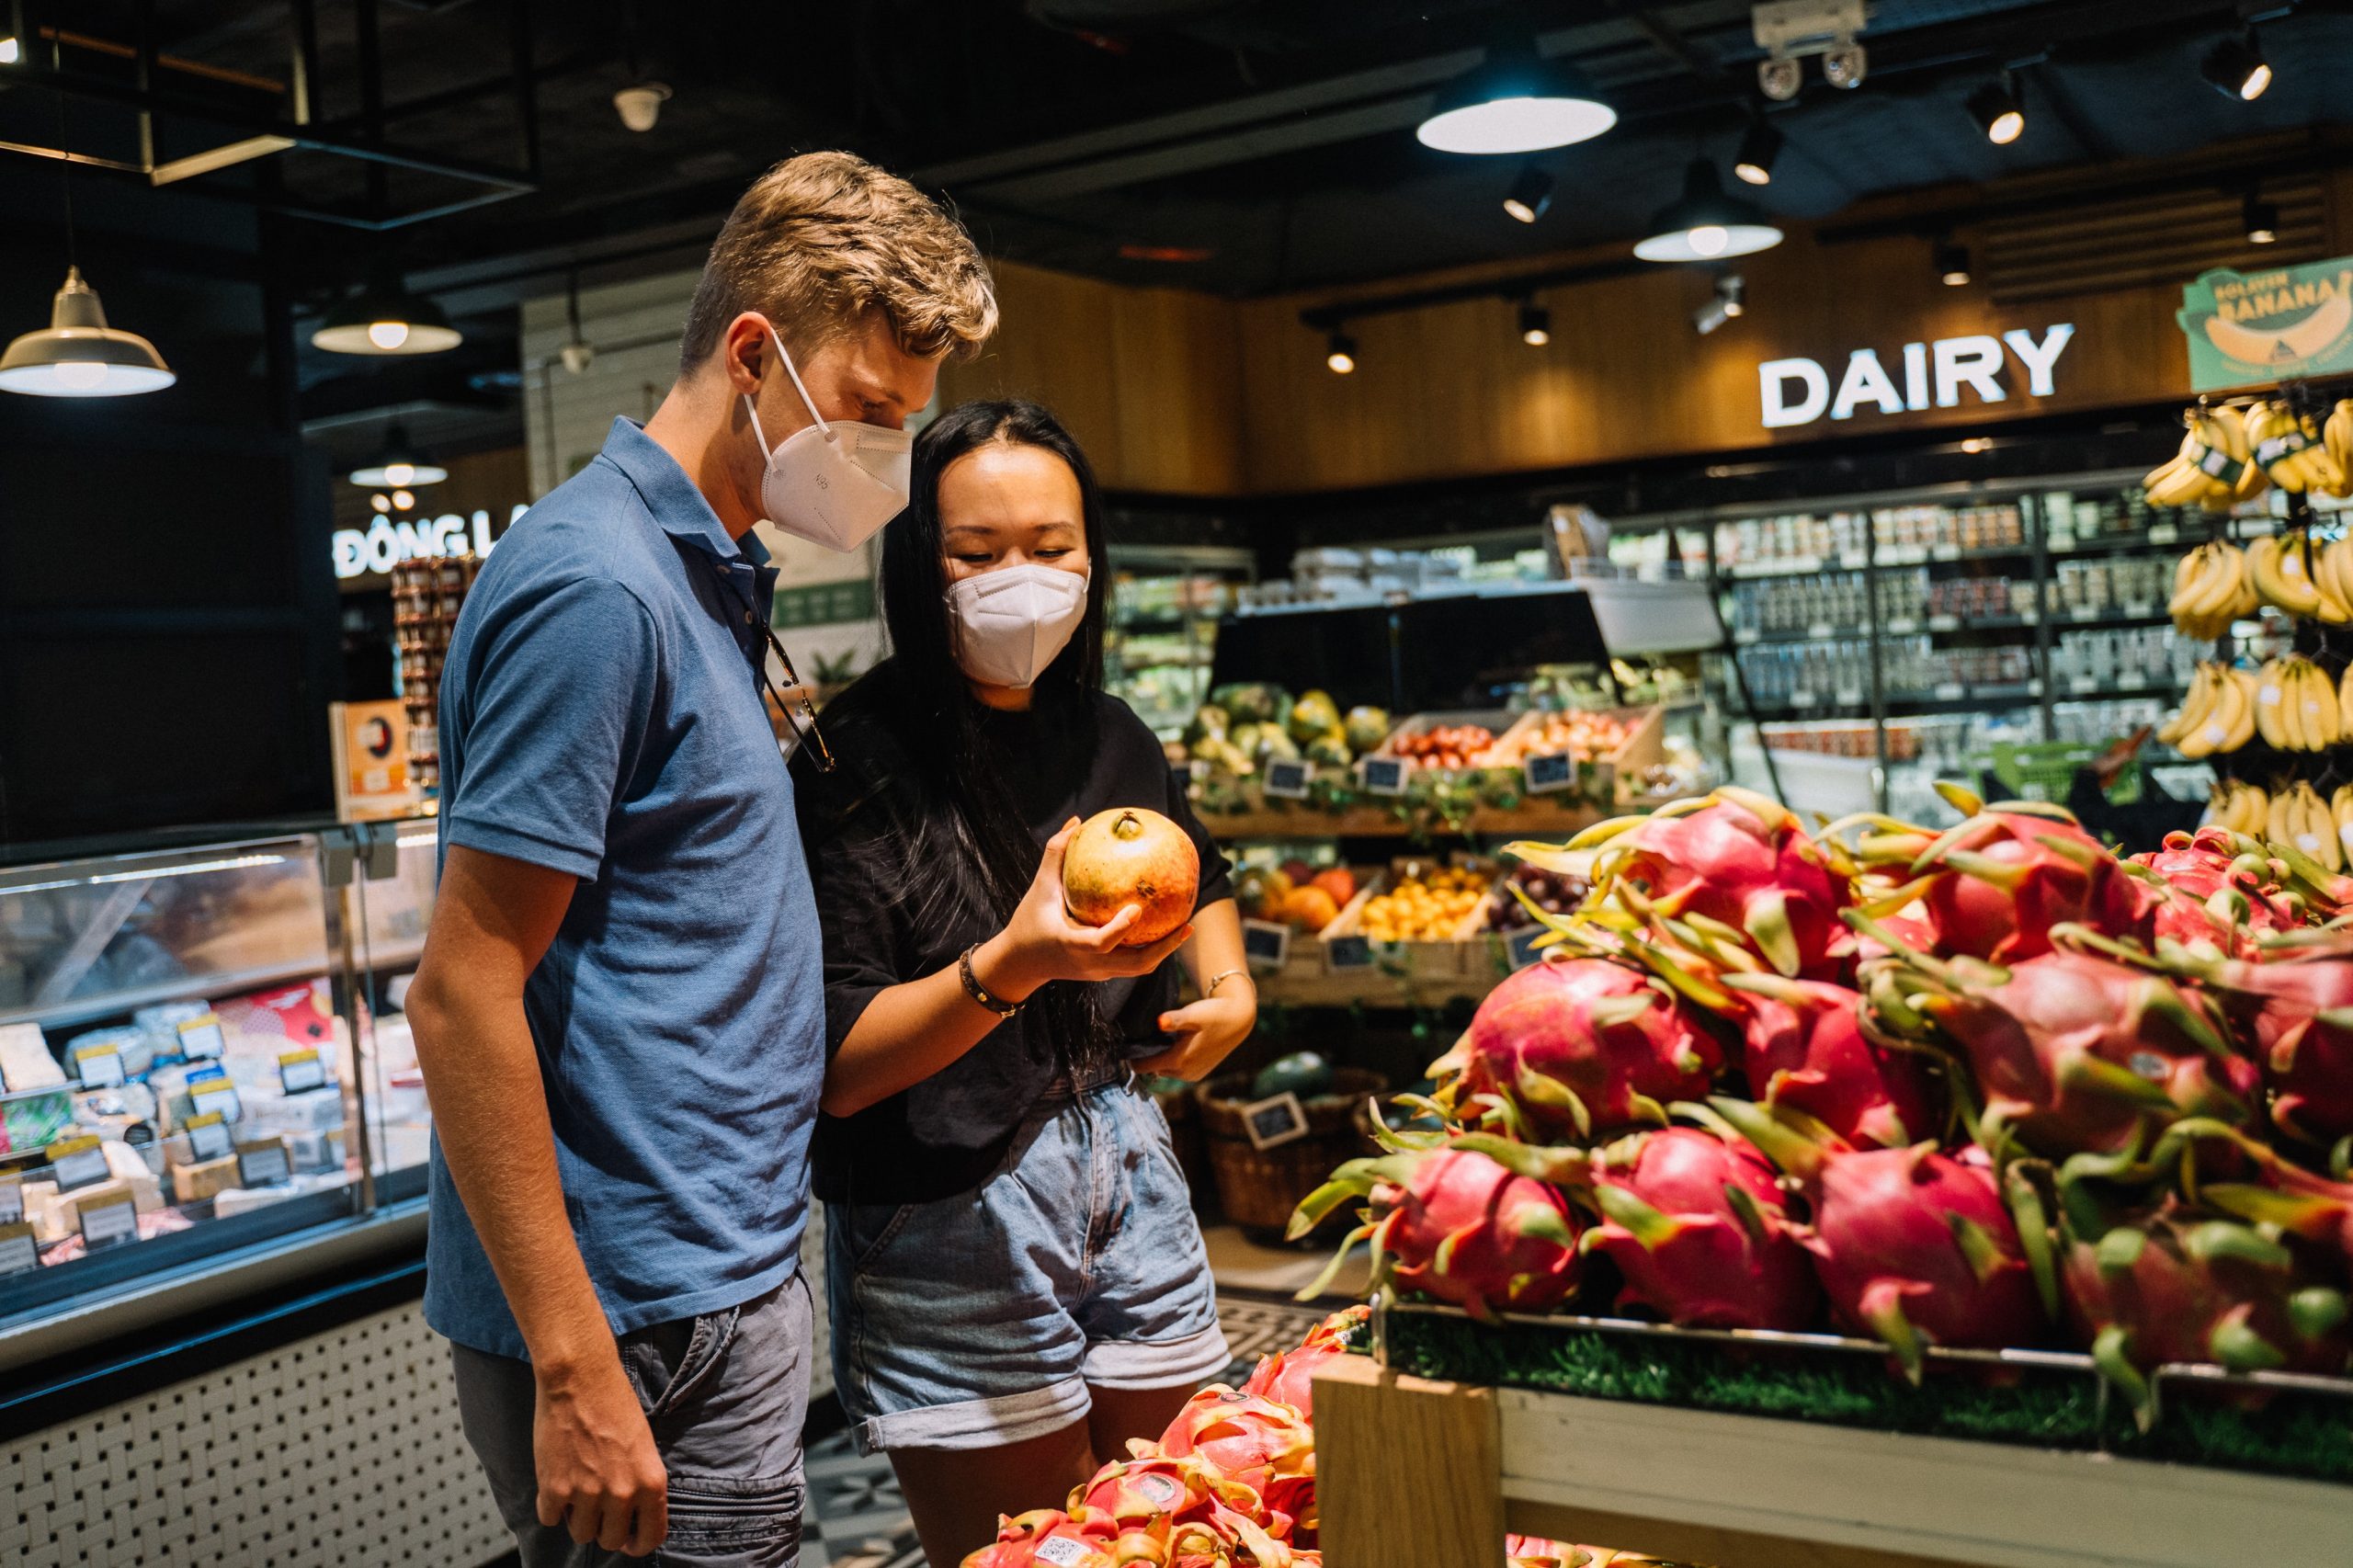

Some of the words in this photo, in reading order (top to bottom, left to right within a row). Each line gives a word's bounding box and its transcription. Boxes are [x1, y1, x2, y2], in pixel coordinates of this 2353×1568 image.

[2218, 278, 2336, 324] BANANA
[1758, 323, 2075, 428] DAIRY
[814, 472, 829, 490] N95
[332, 515, 469, 578] ĐÔNG
